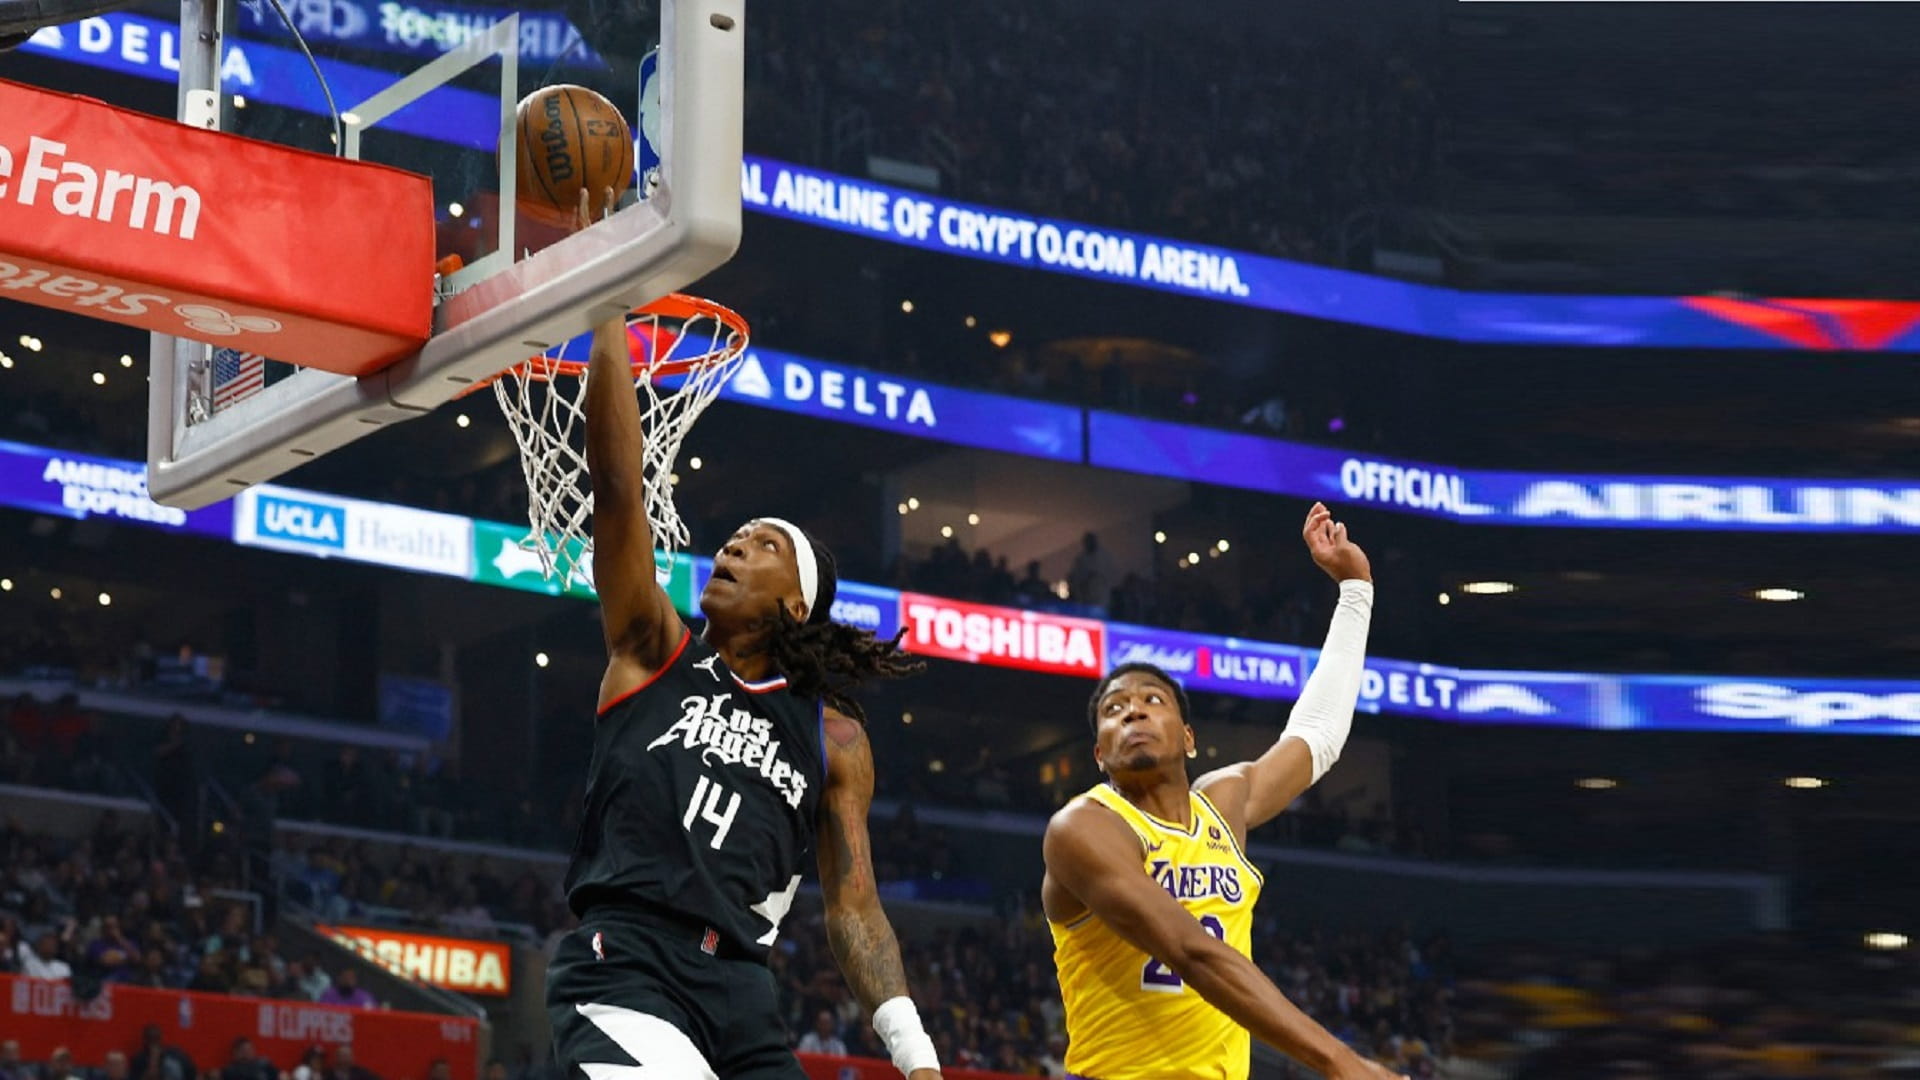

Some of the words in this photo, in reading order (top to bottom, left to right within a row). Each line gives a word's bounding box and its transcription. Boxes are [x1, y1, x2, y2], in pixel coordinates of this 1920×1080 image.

[78, 16, 254, 86] DELA
[541, 94, 574, 184] Wilson
[17, 135, 201, 240] Farm
[772, 169, 889, 232] AIRLINE
[893, 197, 935, 240] OF
[939, 206, 1137, 278] CRYPTO.COM
[1139, 243, 1250, 297] ARENA.
[783, 362, 937, 427] DELTA
[62, 482, 187, 526] EXPRESS
[1340, 458, 1495, 515] OFFICIAL
[263, 502, 339, 541] UCLA
[358, 516, 458, 562] Health
[908, 603, 1097, 667] TOSHIBA
[1213, 653, 1295, 686] ULTRA
[702, 693, 774, 746] Los
[646, 695, 808, 810] Angeles
[682, 774, 742, 850] 14
